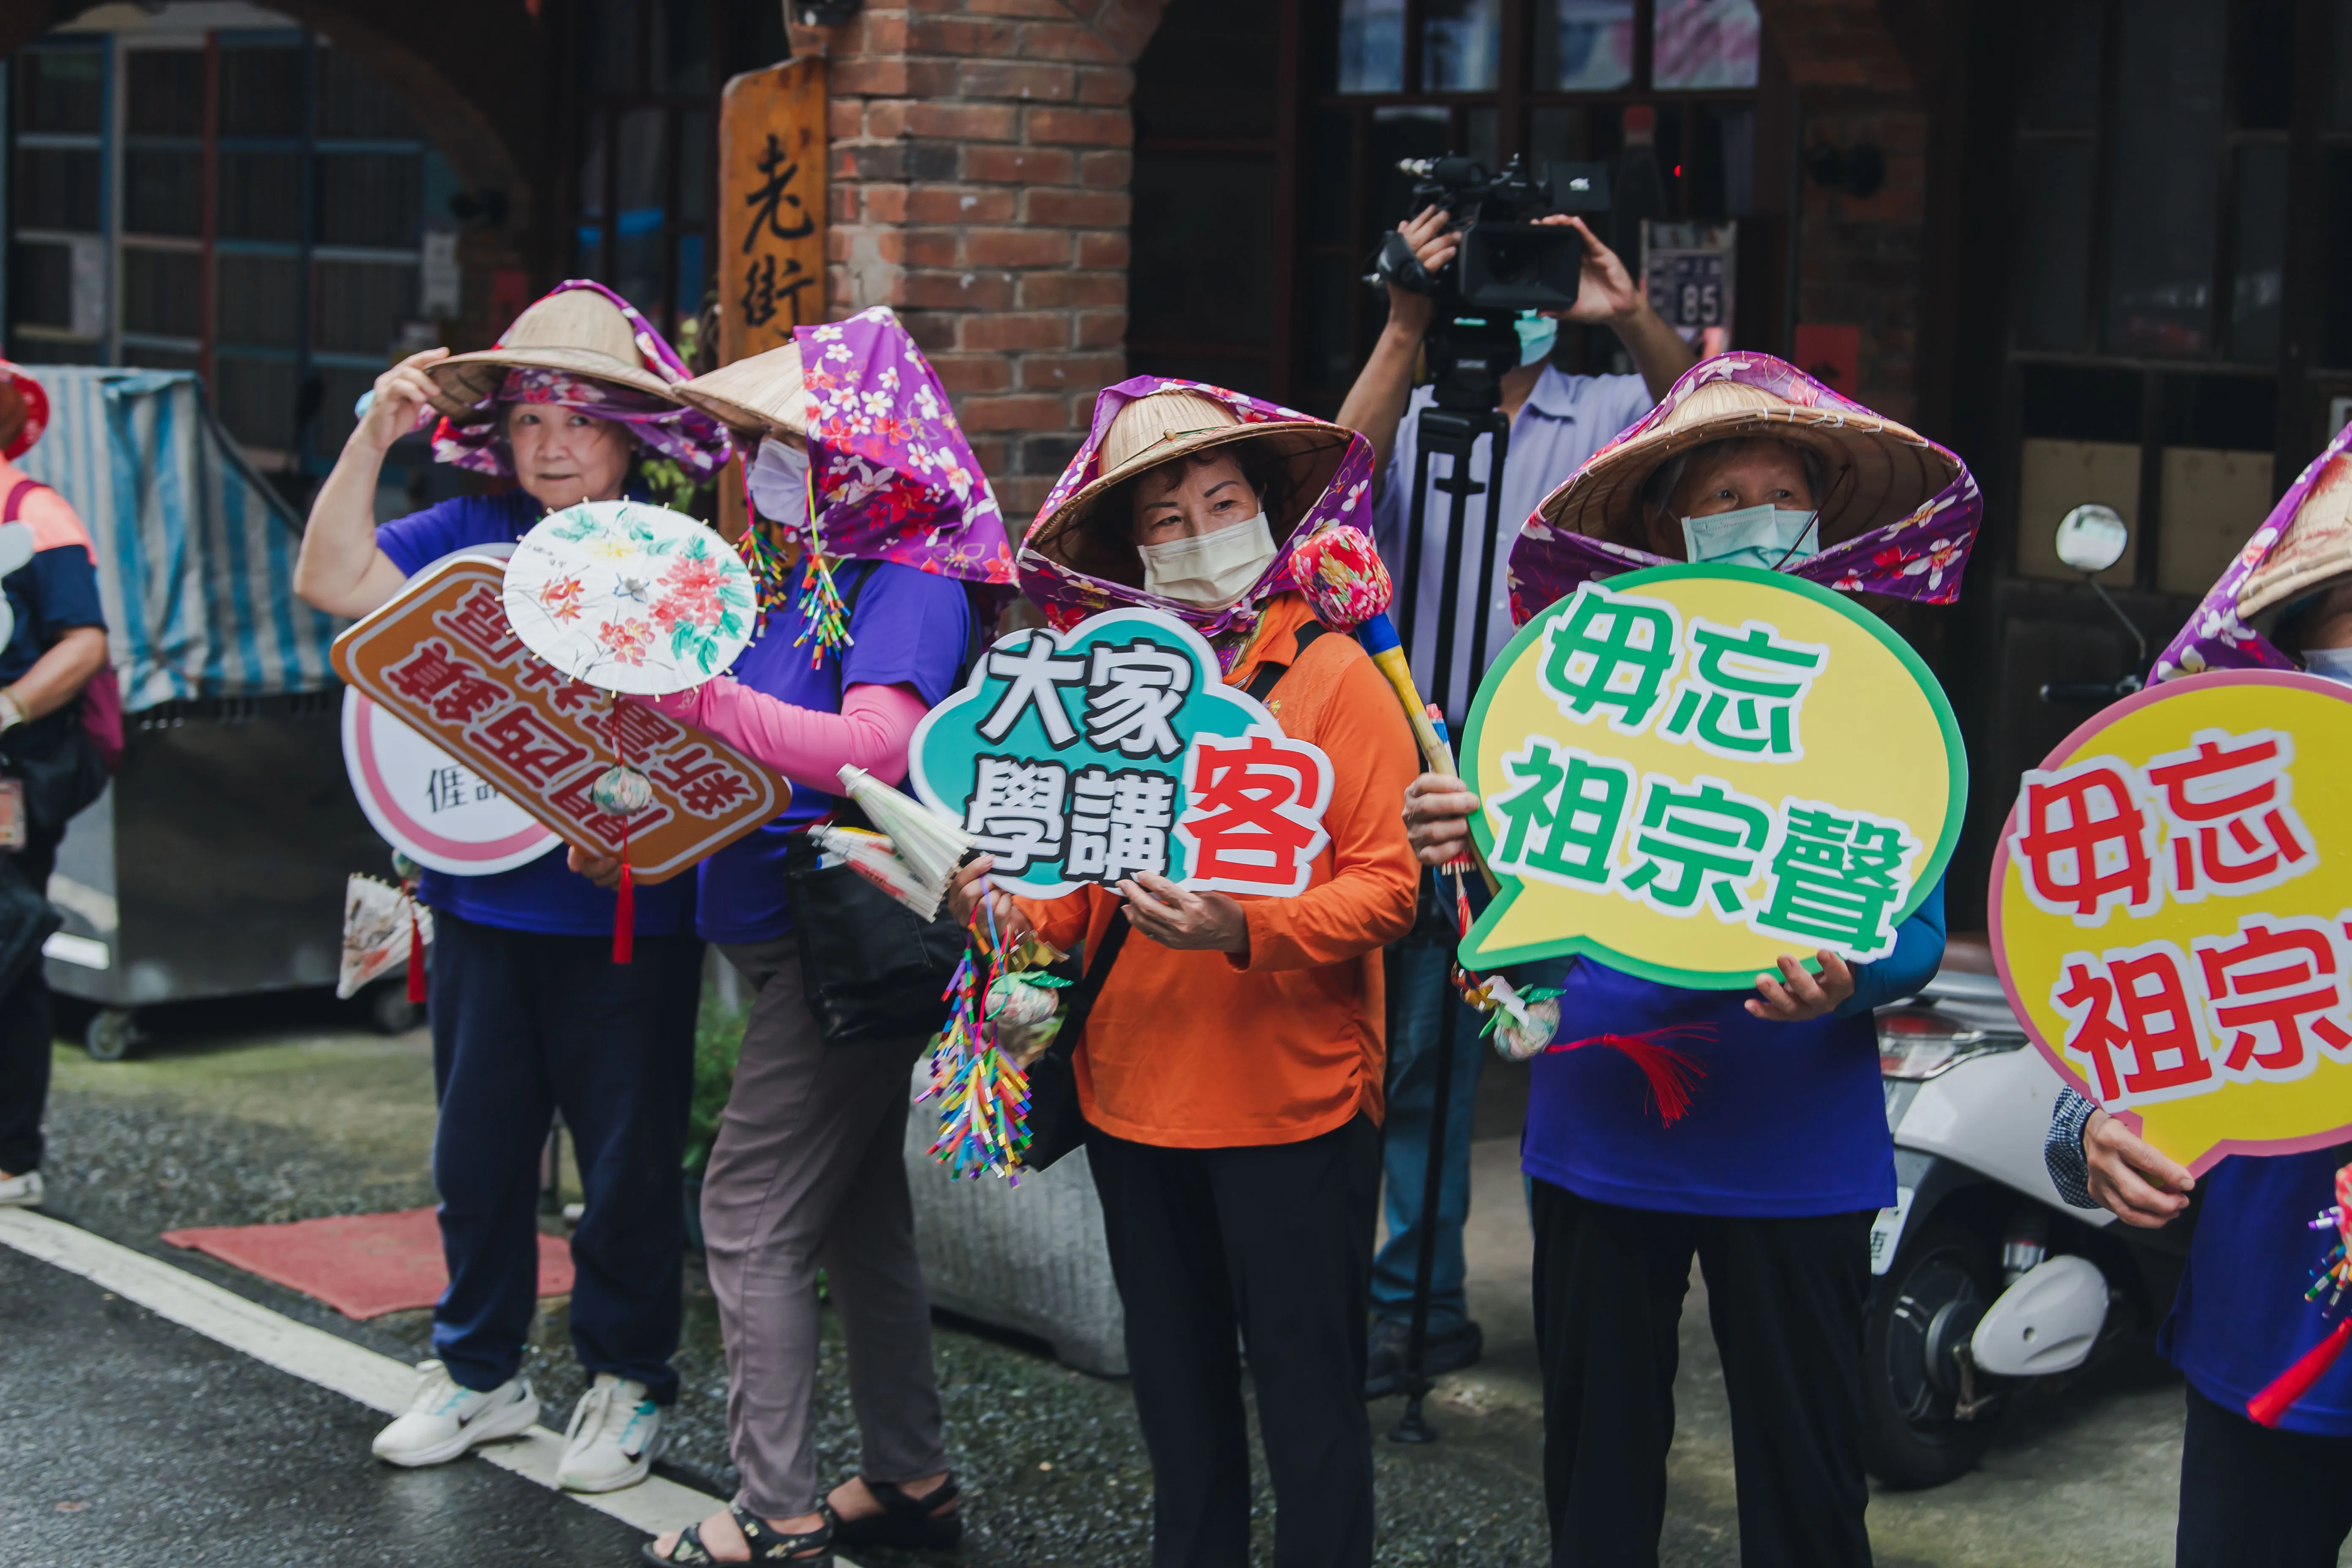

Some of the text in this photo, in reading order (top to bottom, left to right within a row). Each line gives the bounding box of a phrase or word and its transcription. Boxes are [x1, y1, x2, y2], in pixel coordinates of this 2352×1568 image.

[740, 133, 814, 340] 老街
[977, 629, 1192, 760] 大家
[1496, 743, 1914, 953] 祖宗聲
[2056, 926, 2352, 1102] 祖宗
